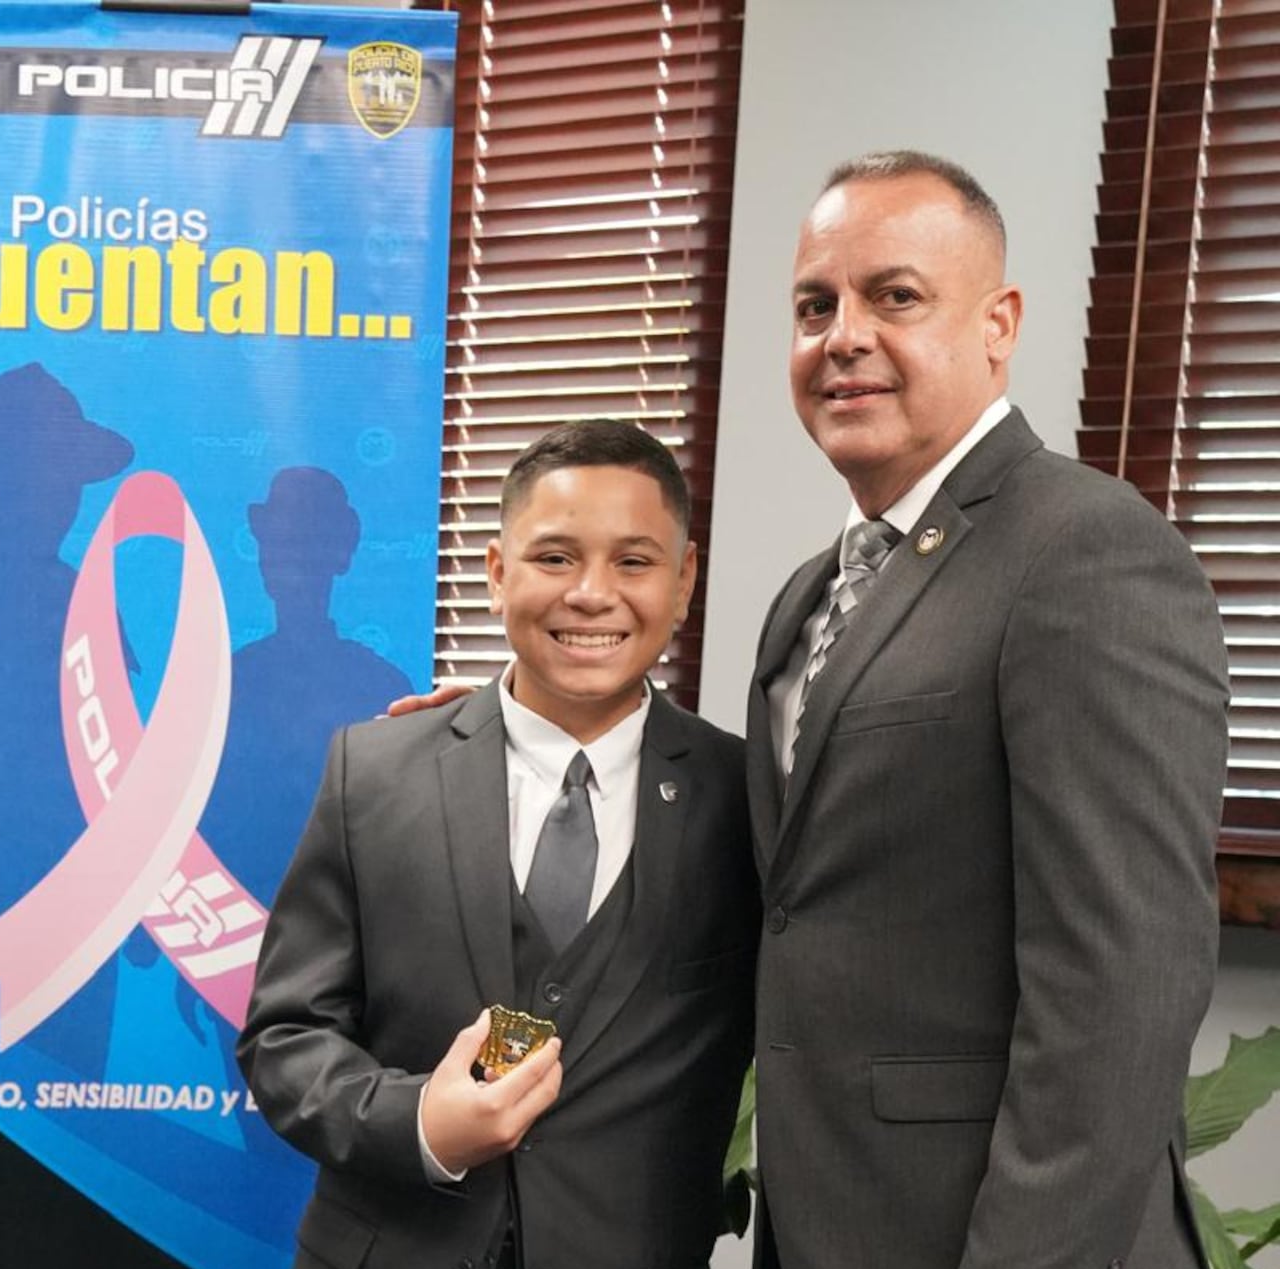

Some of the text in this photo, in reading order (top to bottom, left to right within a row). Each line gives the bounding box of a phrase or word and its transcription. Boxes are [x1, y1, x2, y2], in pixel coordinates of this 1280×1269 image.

[17, 64, 277, 102] POLICIA
[12, 194, 209, 243] Policías
[34, 1081, 216, 1112] SENSIBILIDAD
[220, 1089, 240, 1117] y
